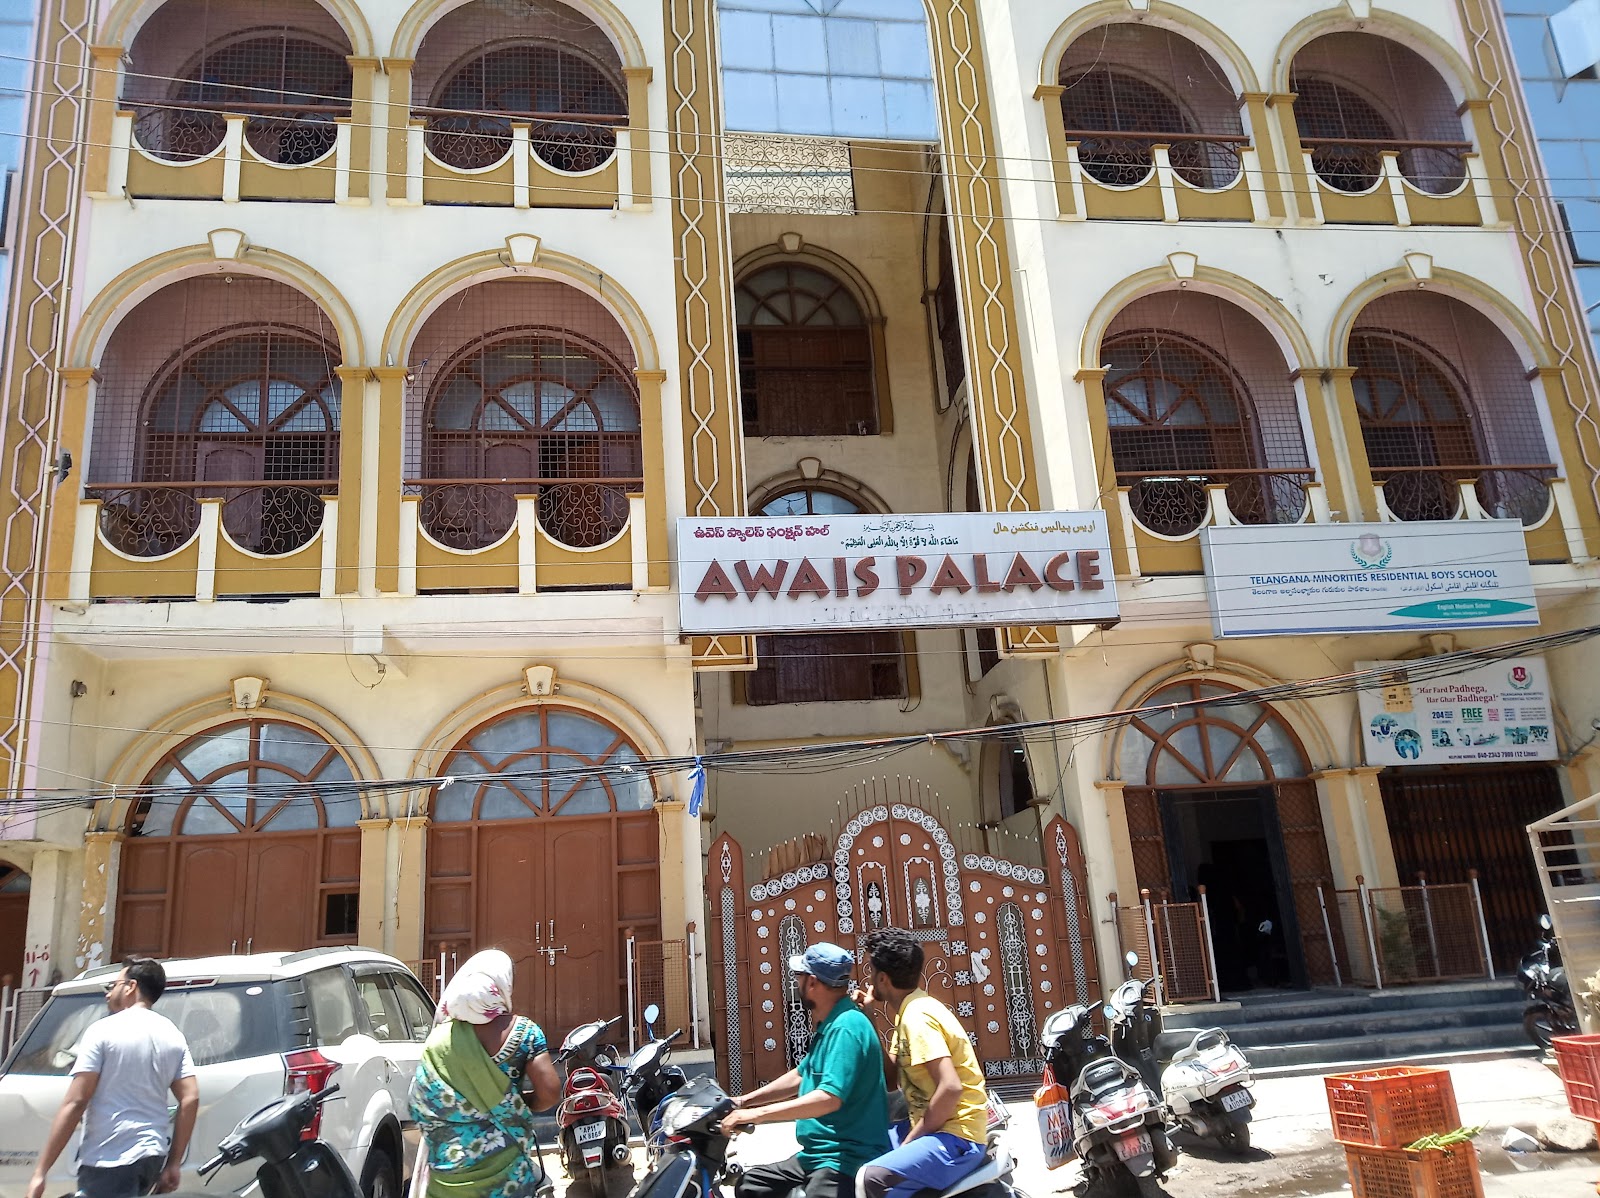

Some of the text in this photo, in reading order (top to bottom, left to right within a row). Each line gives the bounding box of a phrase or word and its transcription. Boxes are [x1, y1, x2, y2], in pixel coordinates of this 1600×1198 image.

[694, 550, 1105, 603] AWAIS PALACE
[1250, 570, 1498, 585] TELANGANA MINORITIES RESIDENTIAL BOYS SCHOOL
[1433, 686, 1448, 694] Fard
[1449, 684, 1488, 695] Padhega,
[1462, 708, 1483, 718] FREE
